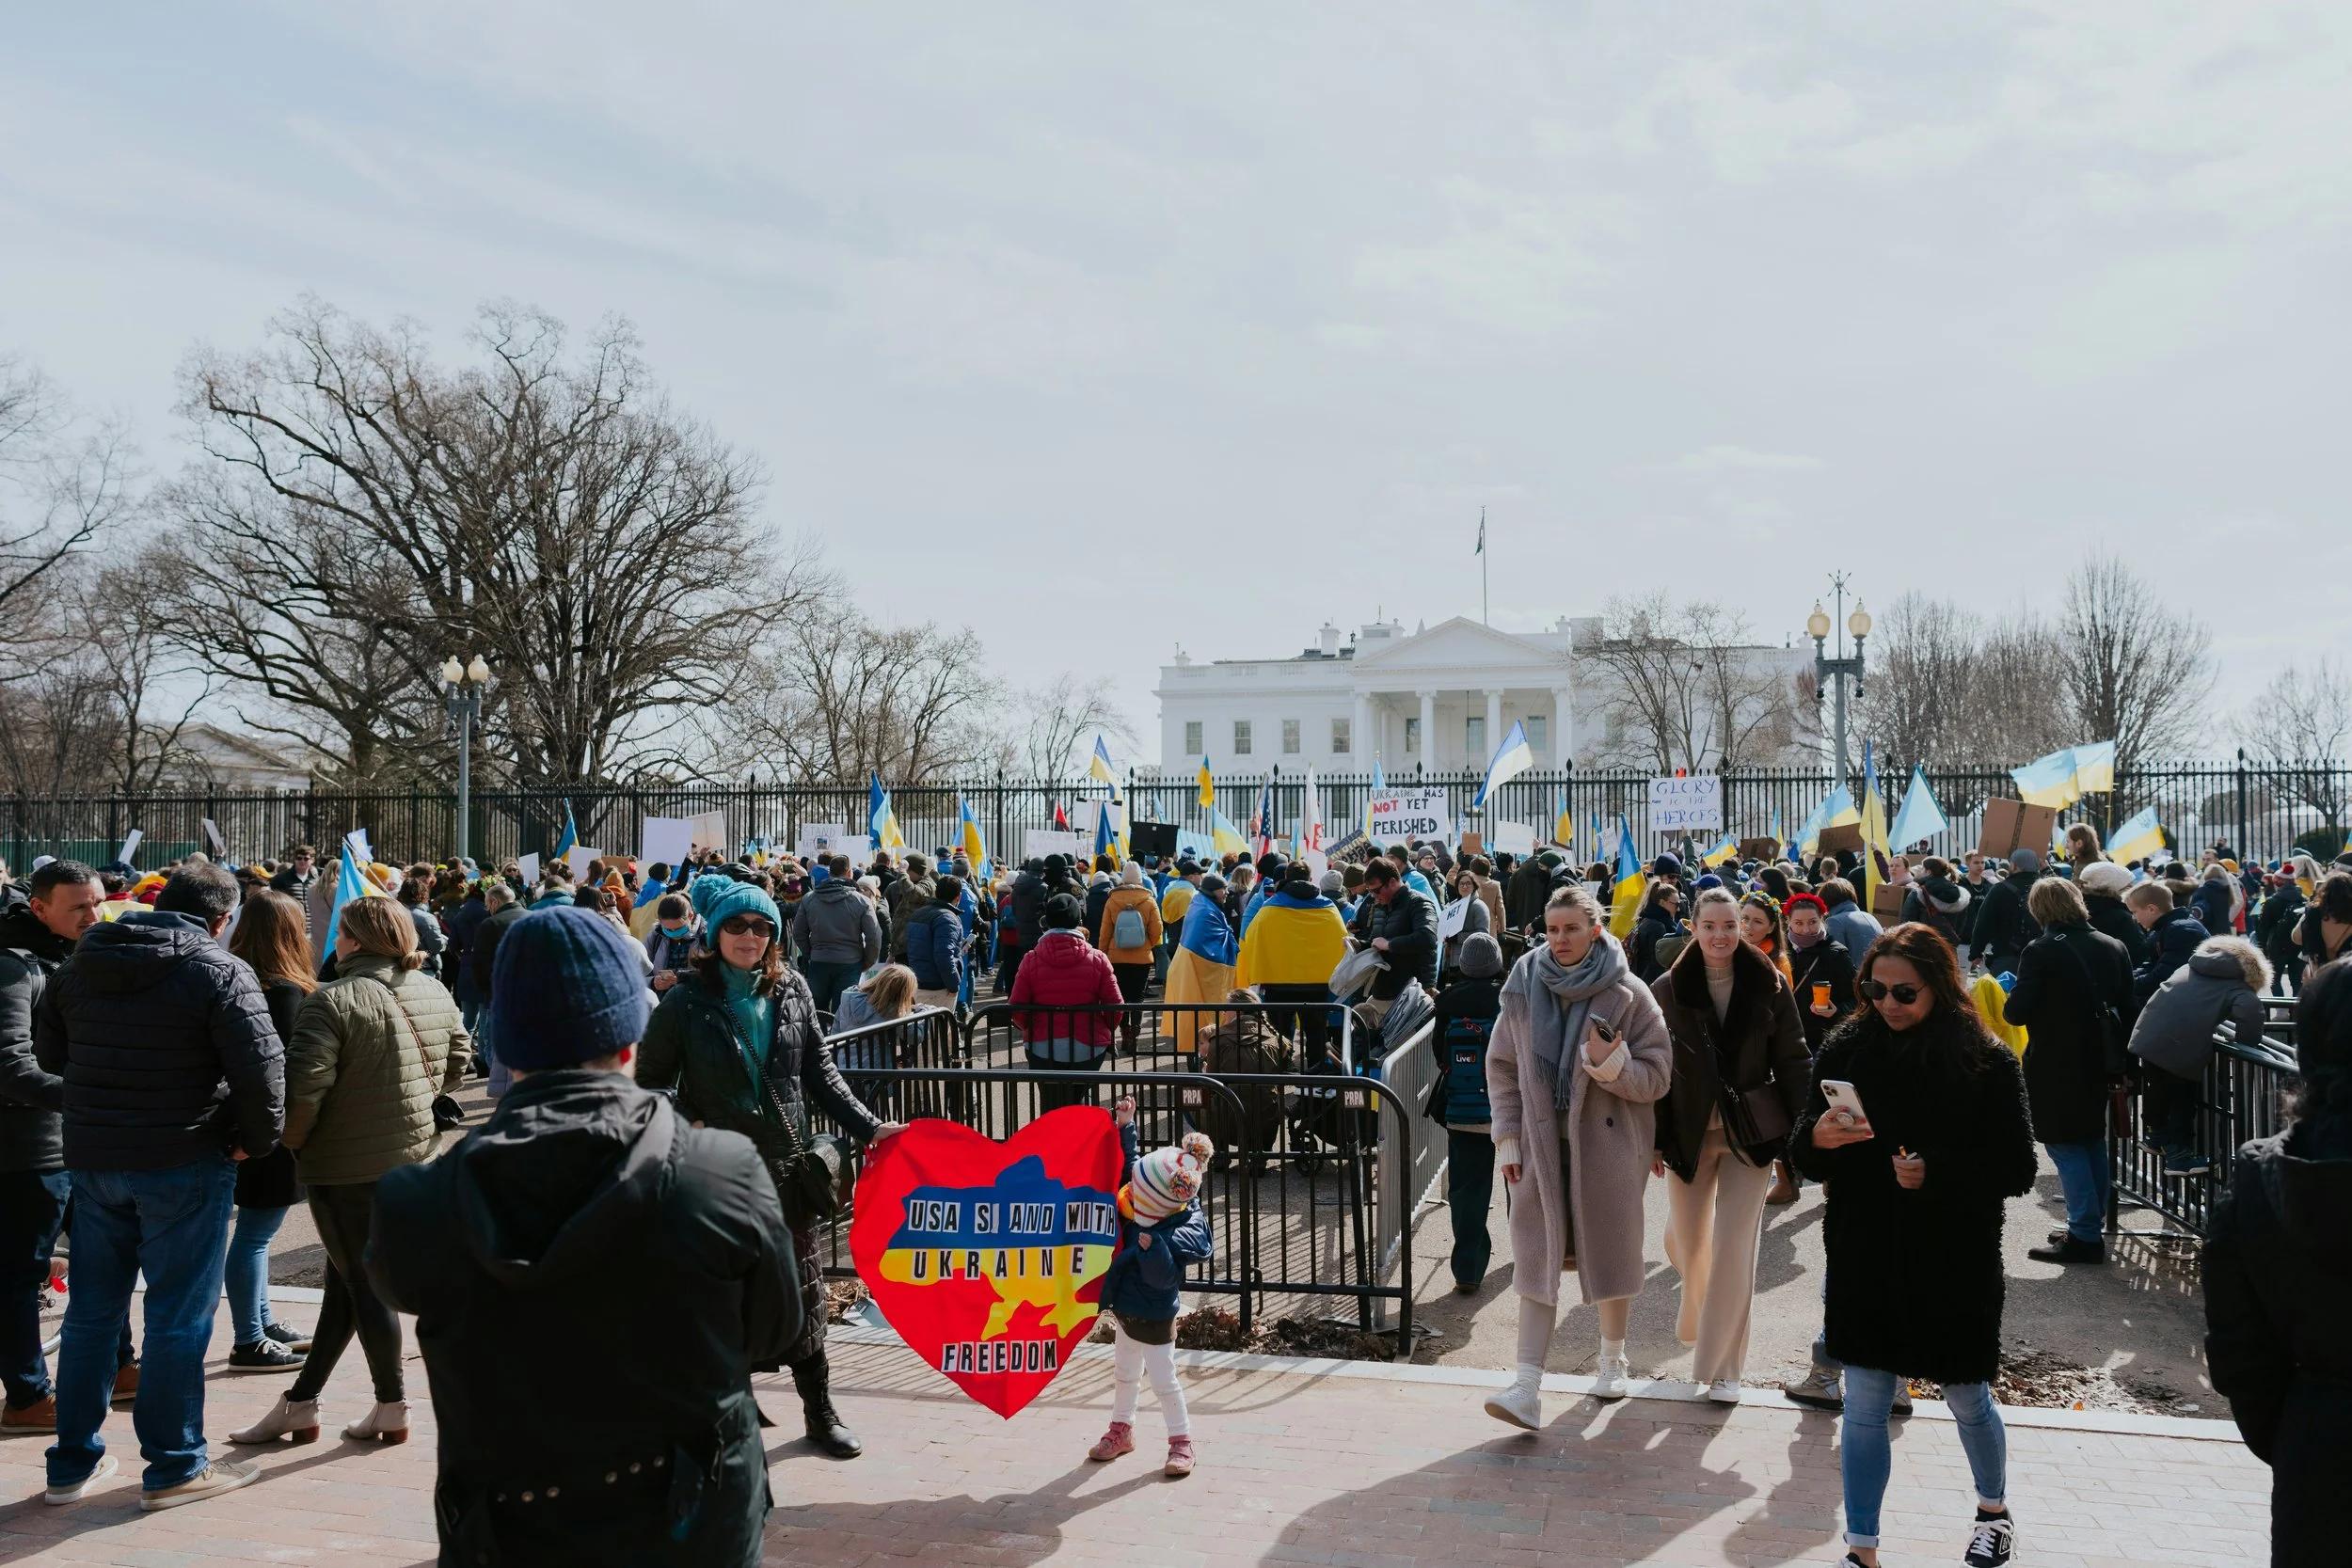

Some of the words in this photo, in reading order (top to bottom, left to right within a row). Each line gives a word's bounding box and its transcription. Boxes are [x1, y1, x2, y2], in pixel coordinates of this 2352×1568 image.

[1372, 788, 1416, 800] UKRAINE
[1423, 788, 1444, 798] HAS
[1373, 800, 1399, 814] NOT
[1406, 799, 1429, 810] YET
[803, 825, 836, 837] STAND
[1373, 817, 1438, 836] PERISHED
[1183, 1089, 1202, 1104] PRPA
[1344, 1091, 1364, 1105] PRPA
[911, 1202, 958, 1230] USA
[977, 1204, 1054, 1233] SAND
[1068, 1203, 1115, 1235] WITH
[914, 1247, 1084, 1279] UKRAINE
[944, 1340, 1057, 1372] FREEDOM
